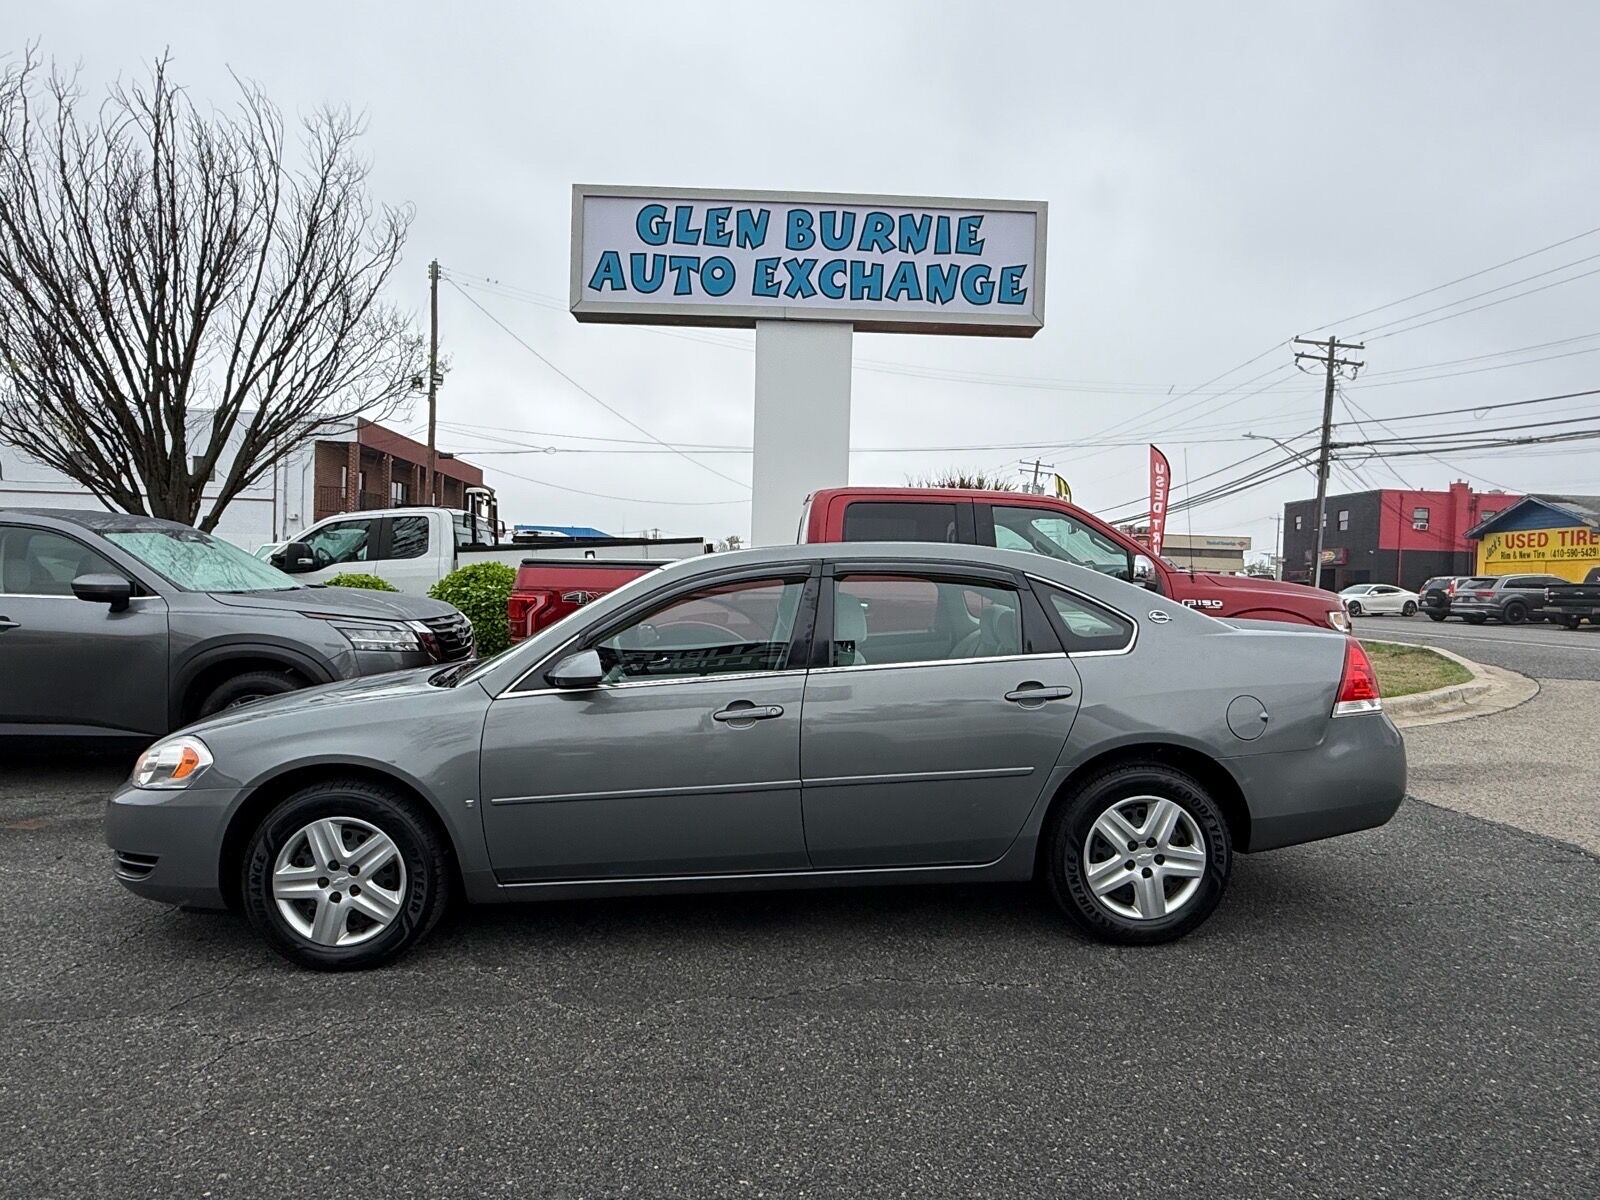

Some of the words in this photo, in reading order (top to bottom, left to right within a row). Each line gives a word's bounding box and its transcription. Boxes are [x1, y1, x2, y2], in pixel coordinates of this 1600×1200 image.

[635, 203, 771, 250] GLEN
[785, 208, 985, 256] BURNIE
[588, 250, 736, 297] AUTO
[752, 256, 1028, 306] EXCHANGE
[1500, 551, 1511, 560] Rim
[1512, 550, 1517, 560] &
[1518, 550, 1531, 560] New
[1533, 549, 1546, 559] Tire
[1504, 532, 1549, 549] USED
[1557, 529, 1600, 547] TIRE
